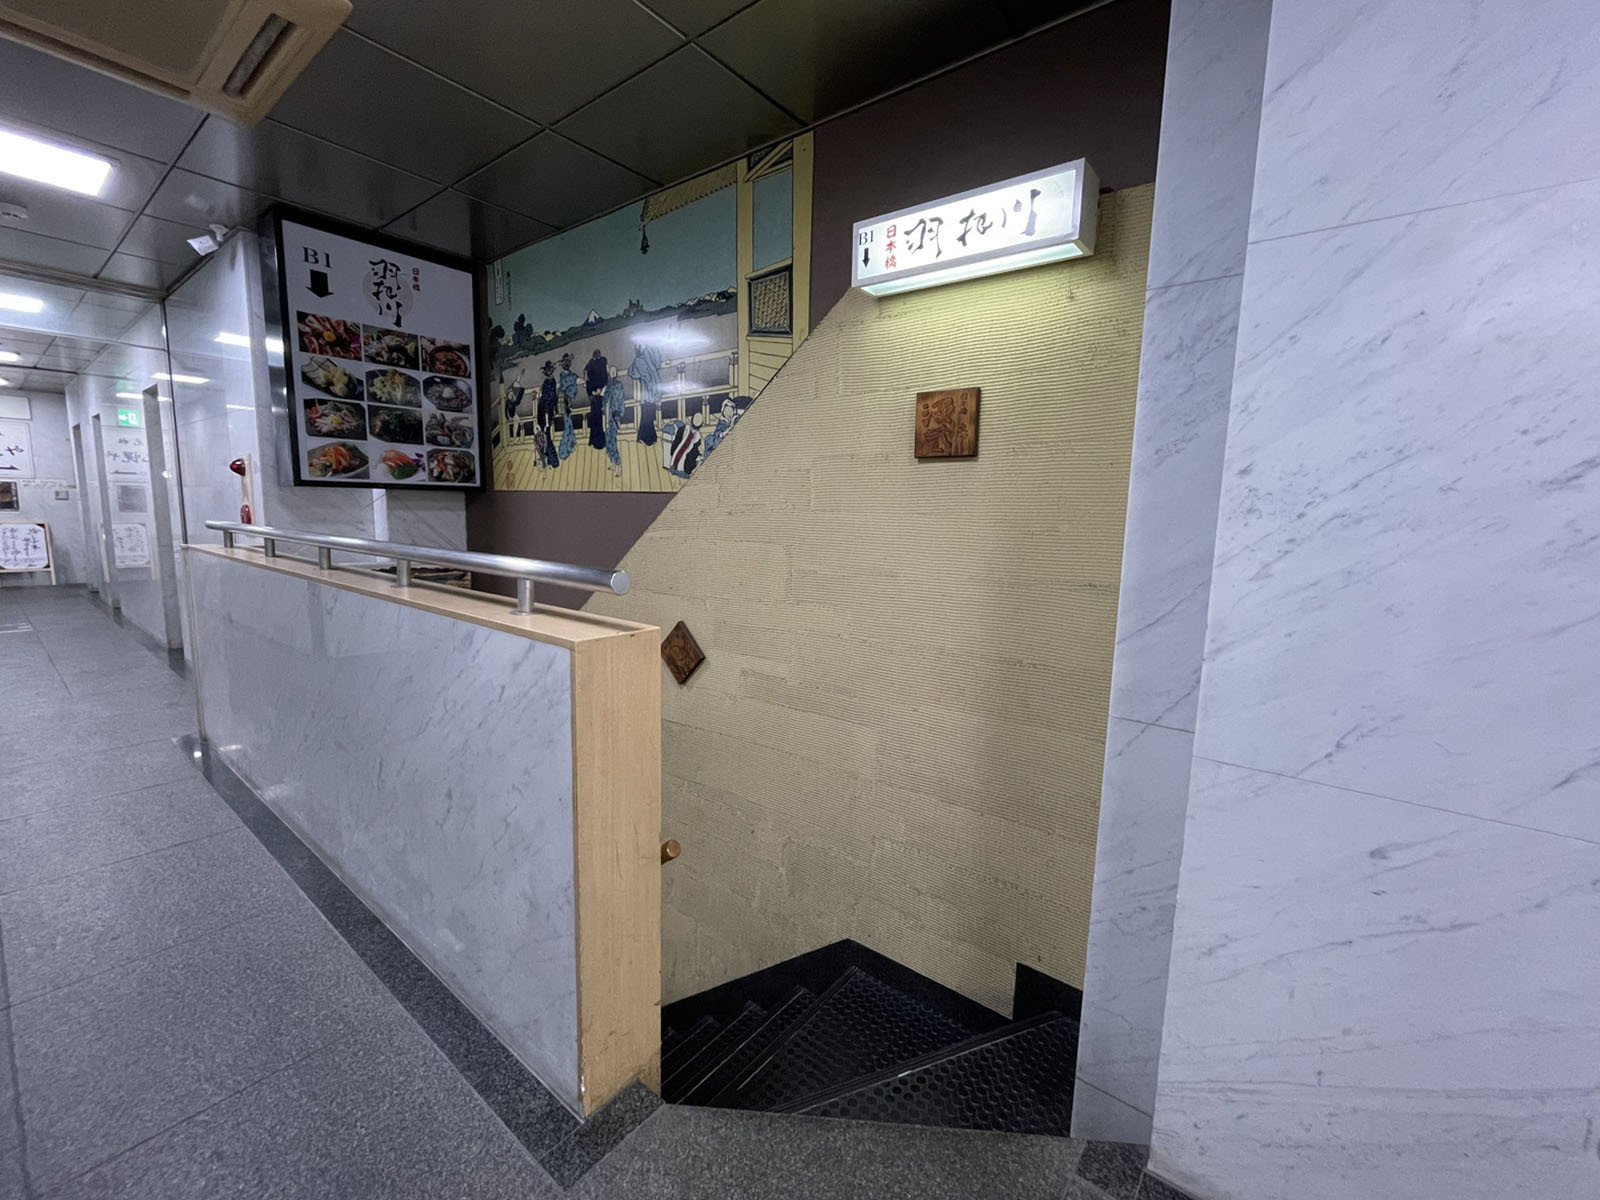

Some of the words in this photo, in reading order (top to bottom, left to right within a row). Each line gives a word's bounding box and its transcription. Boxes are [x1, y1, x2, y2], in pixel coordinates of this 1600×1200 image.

[859, 230, 874, 246] B1
[885, 224, 898, 270] 日本橋
[302, 246, 333, 269] B1
